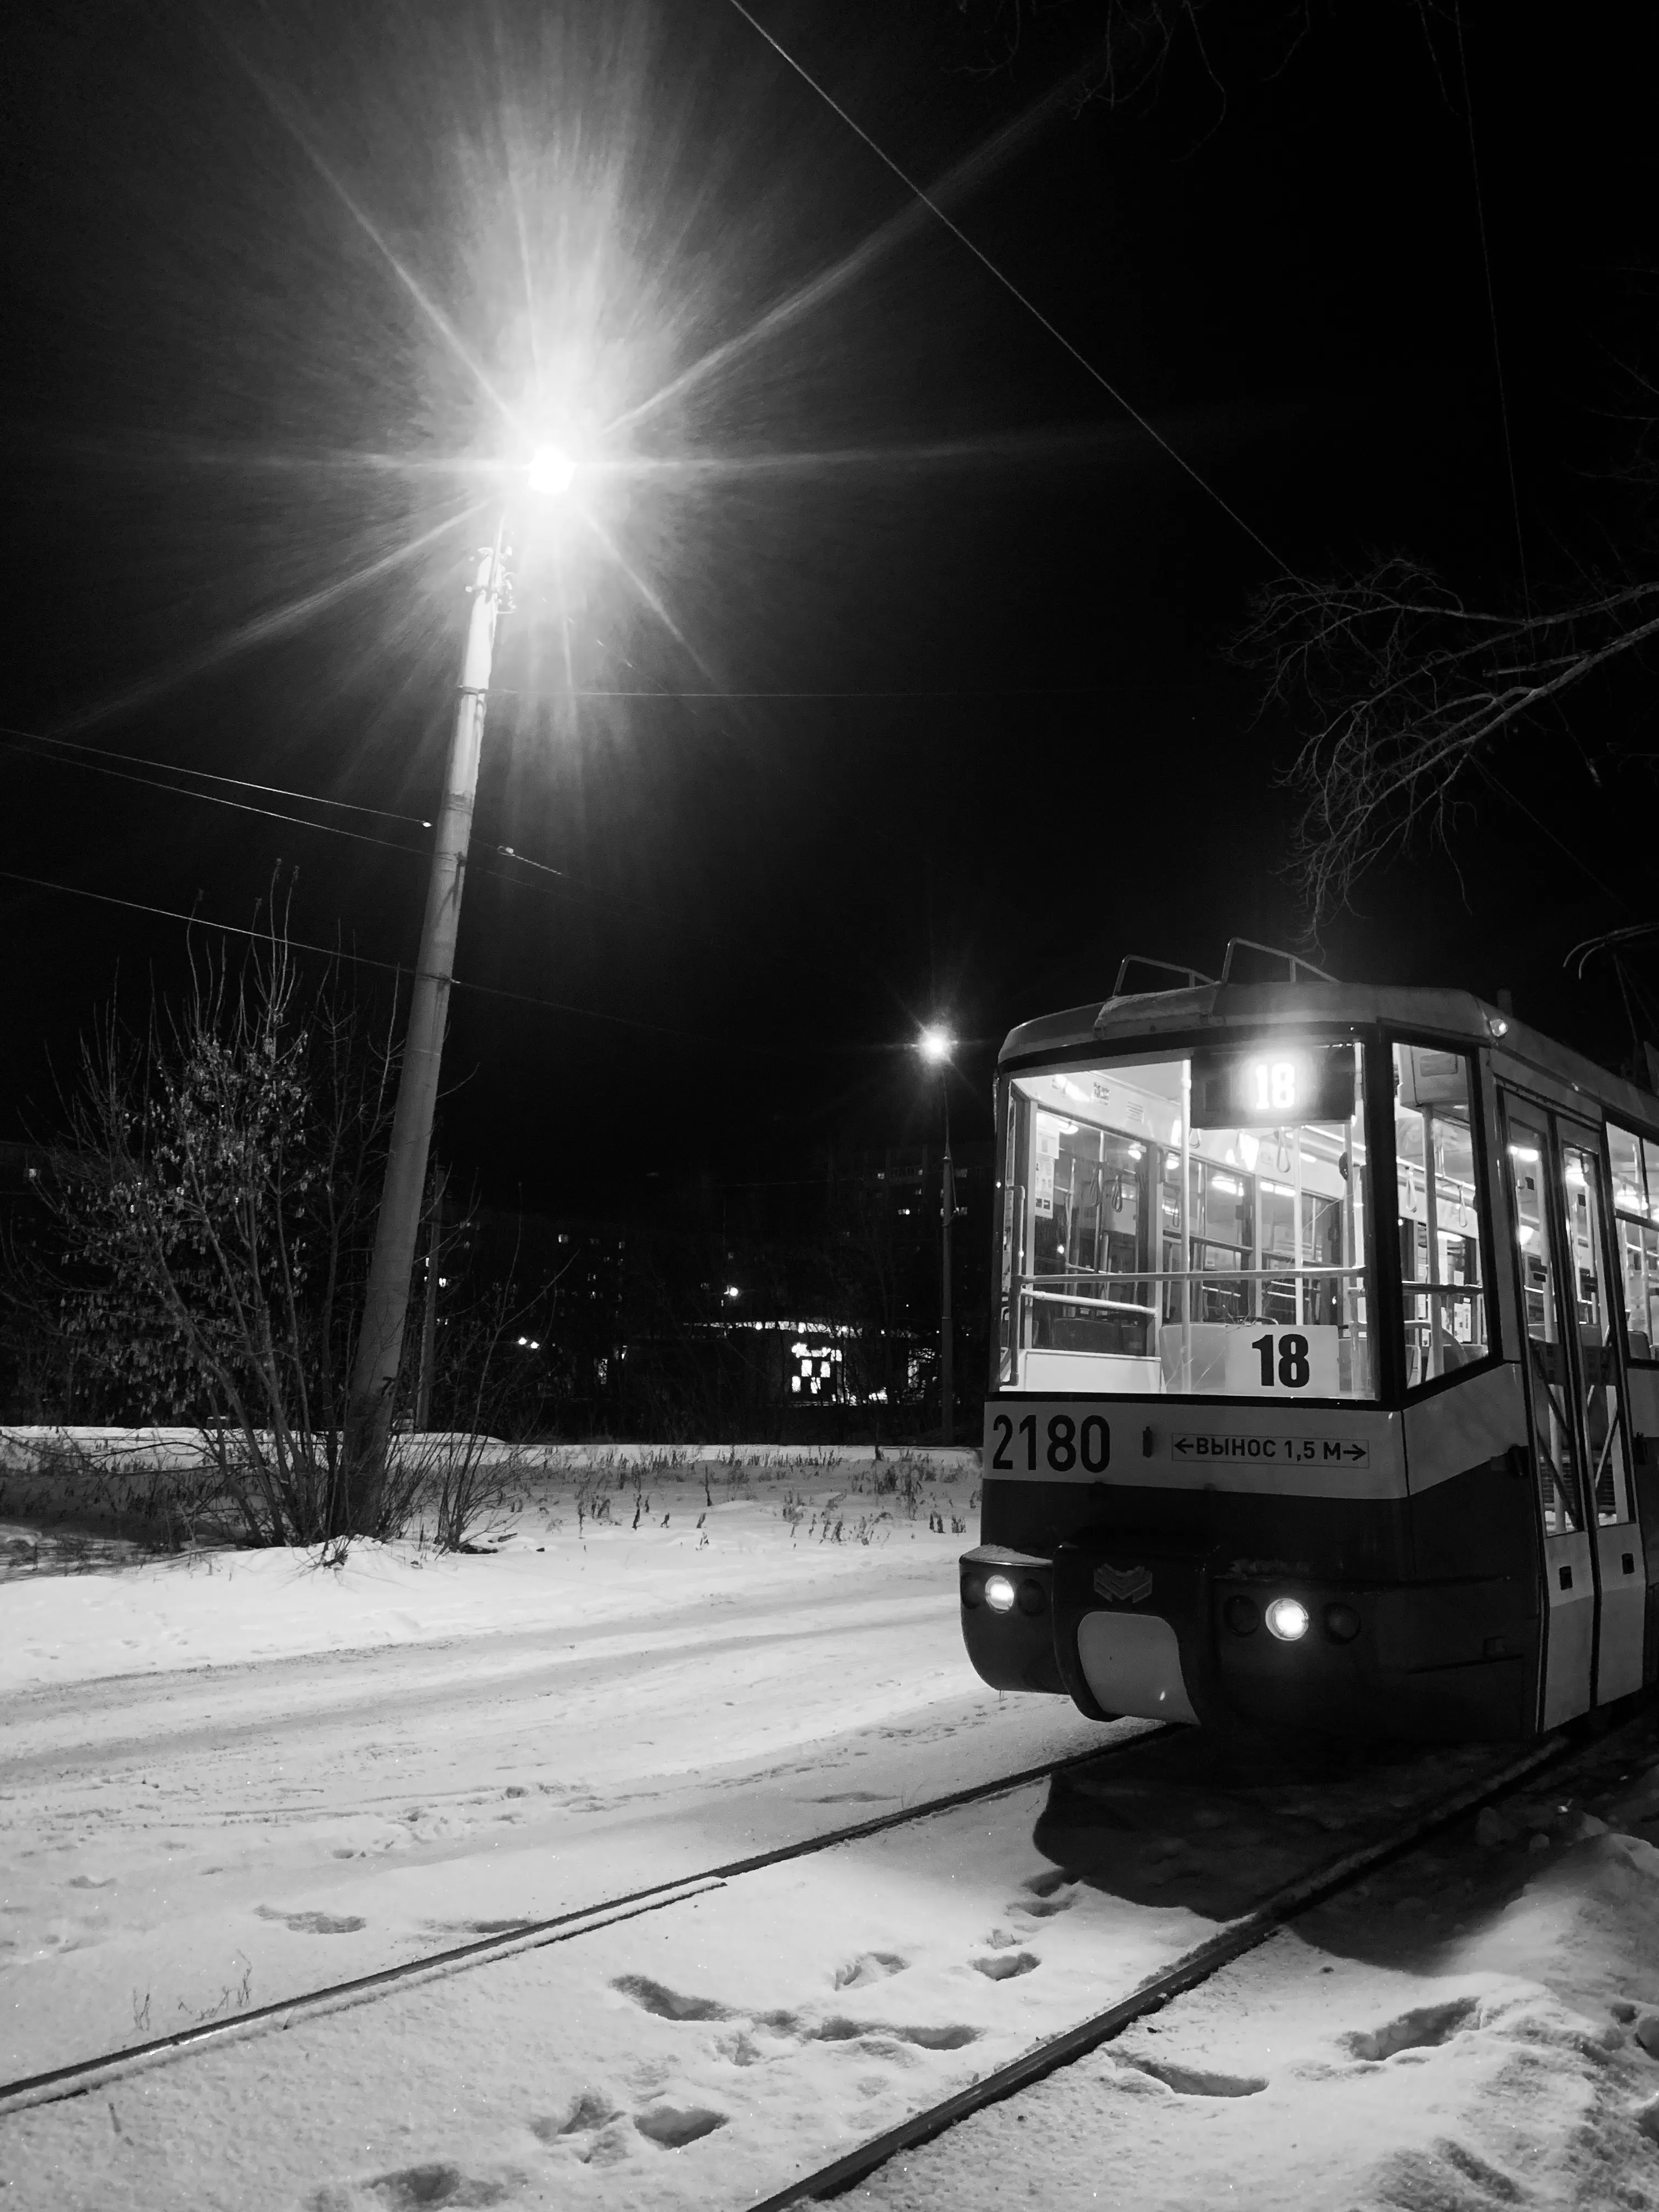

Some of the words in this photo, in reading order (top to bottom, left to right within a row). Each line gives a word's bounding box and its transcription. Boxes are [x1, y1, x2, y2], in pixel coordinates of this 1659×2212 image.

[1255, 1062, 1295, 1110] 18
[1252, 1334, 1310, 1388] 18
[992, 1414, 1110, 1473] 2180
[1195, 1437, 1276, 1458] ВЫНОС
[1284, 1440, 1316, 1462] 1,5
[1323, 1441, 1341, 1460] М
